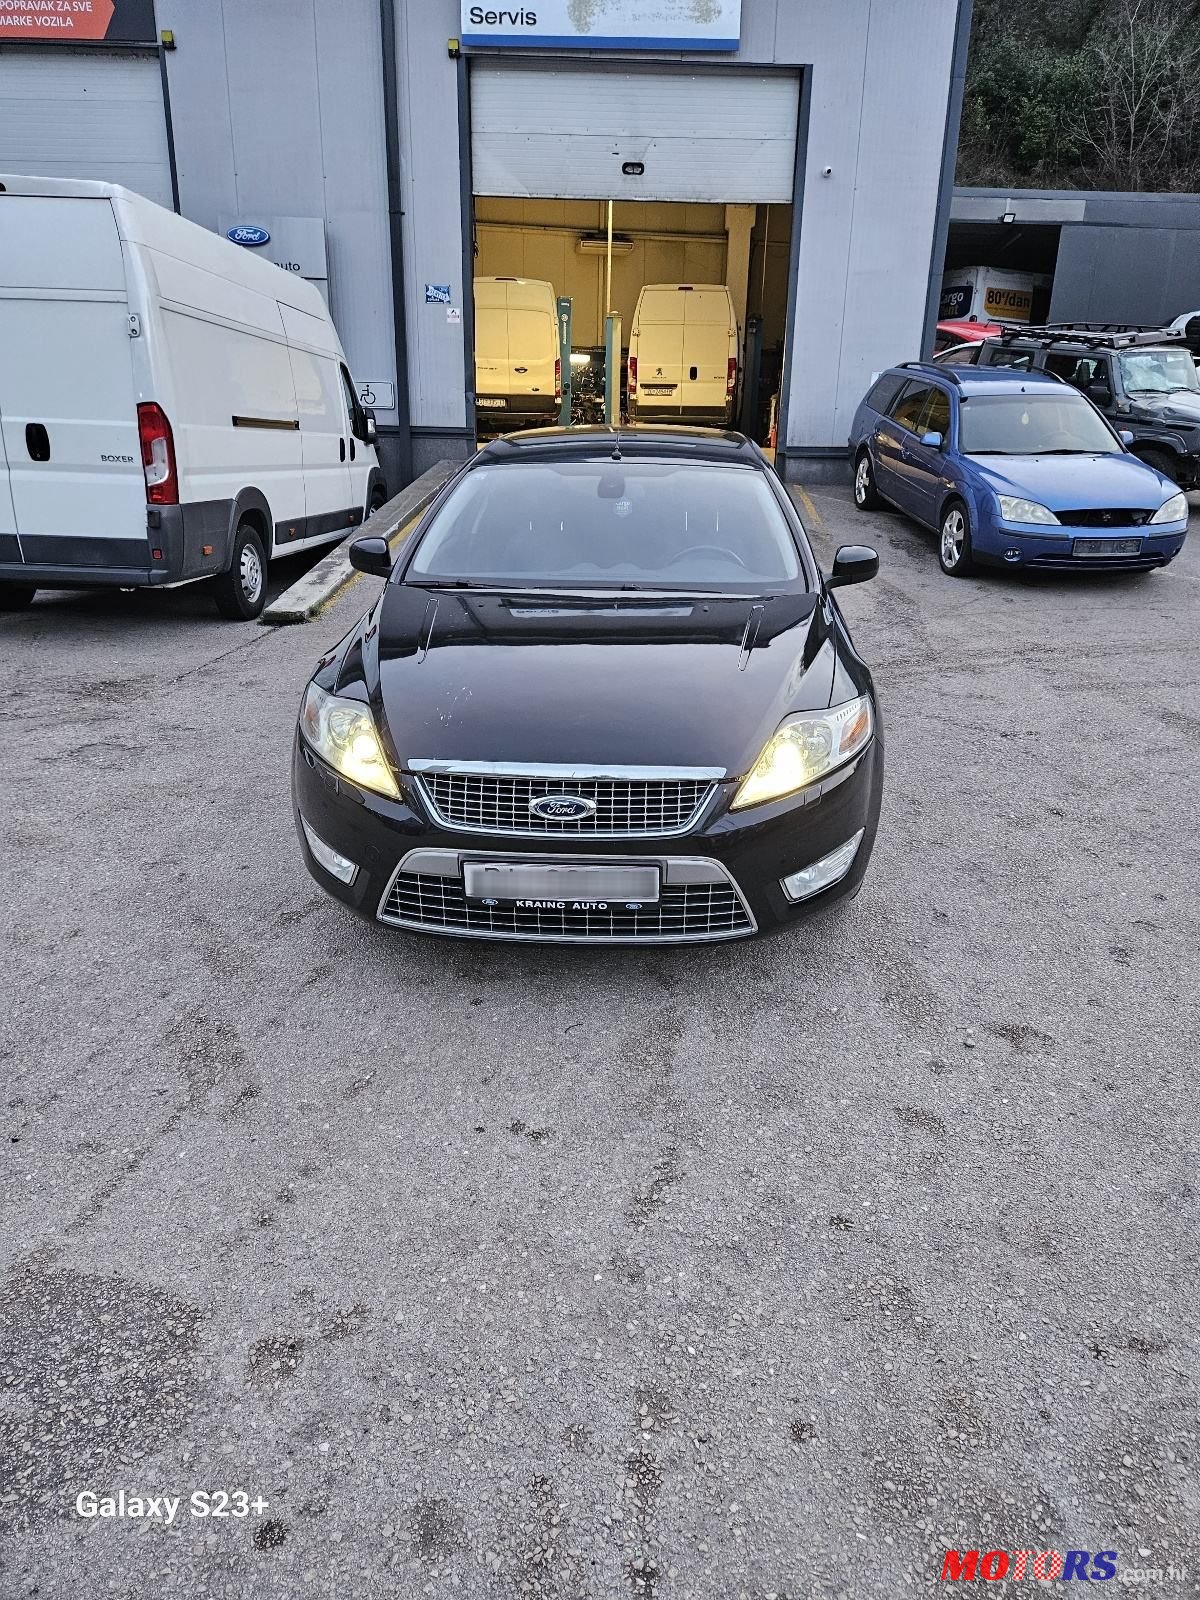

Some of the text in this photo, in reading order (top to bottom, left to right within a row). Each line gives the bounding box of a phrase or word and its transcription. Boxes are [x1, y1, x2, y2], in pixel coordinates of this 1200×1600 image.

[0, 0, 93, 12] POPRAVAK ZA SVE
[34, 16, 74, 27] VOZILA
[469, 6, 537, 26] Servis
[234, 229, 261, 241] Ford
[100, 454, 134, 464] BOXER
[547, 801, 577, 814] Ford
[516, 900, 608, 911] KRAINC AUTO
